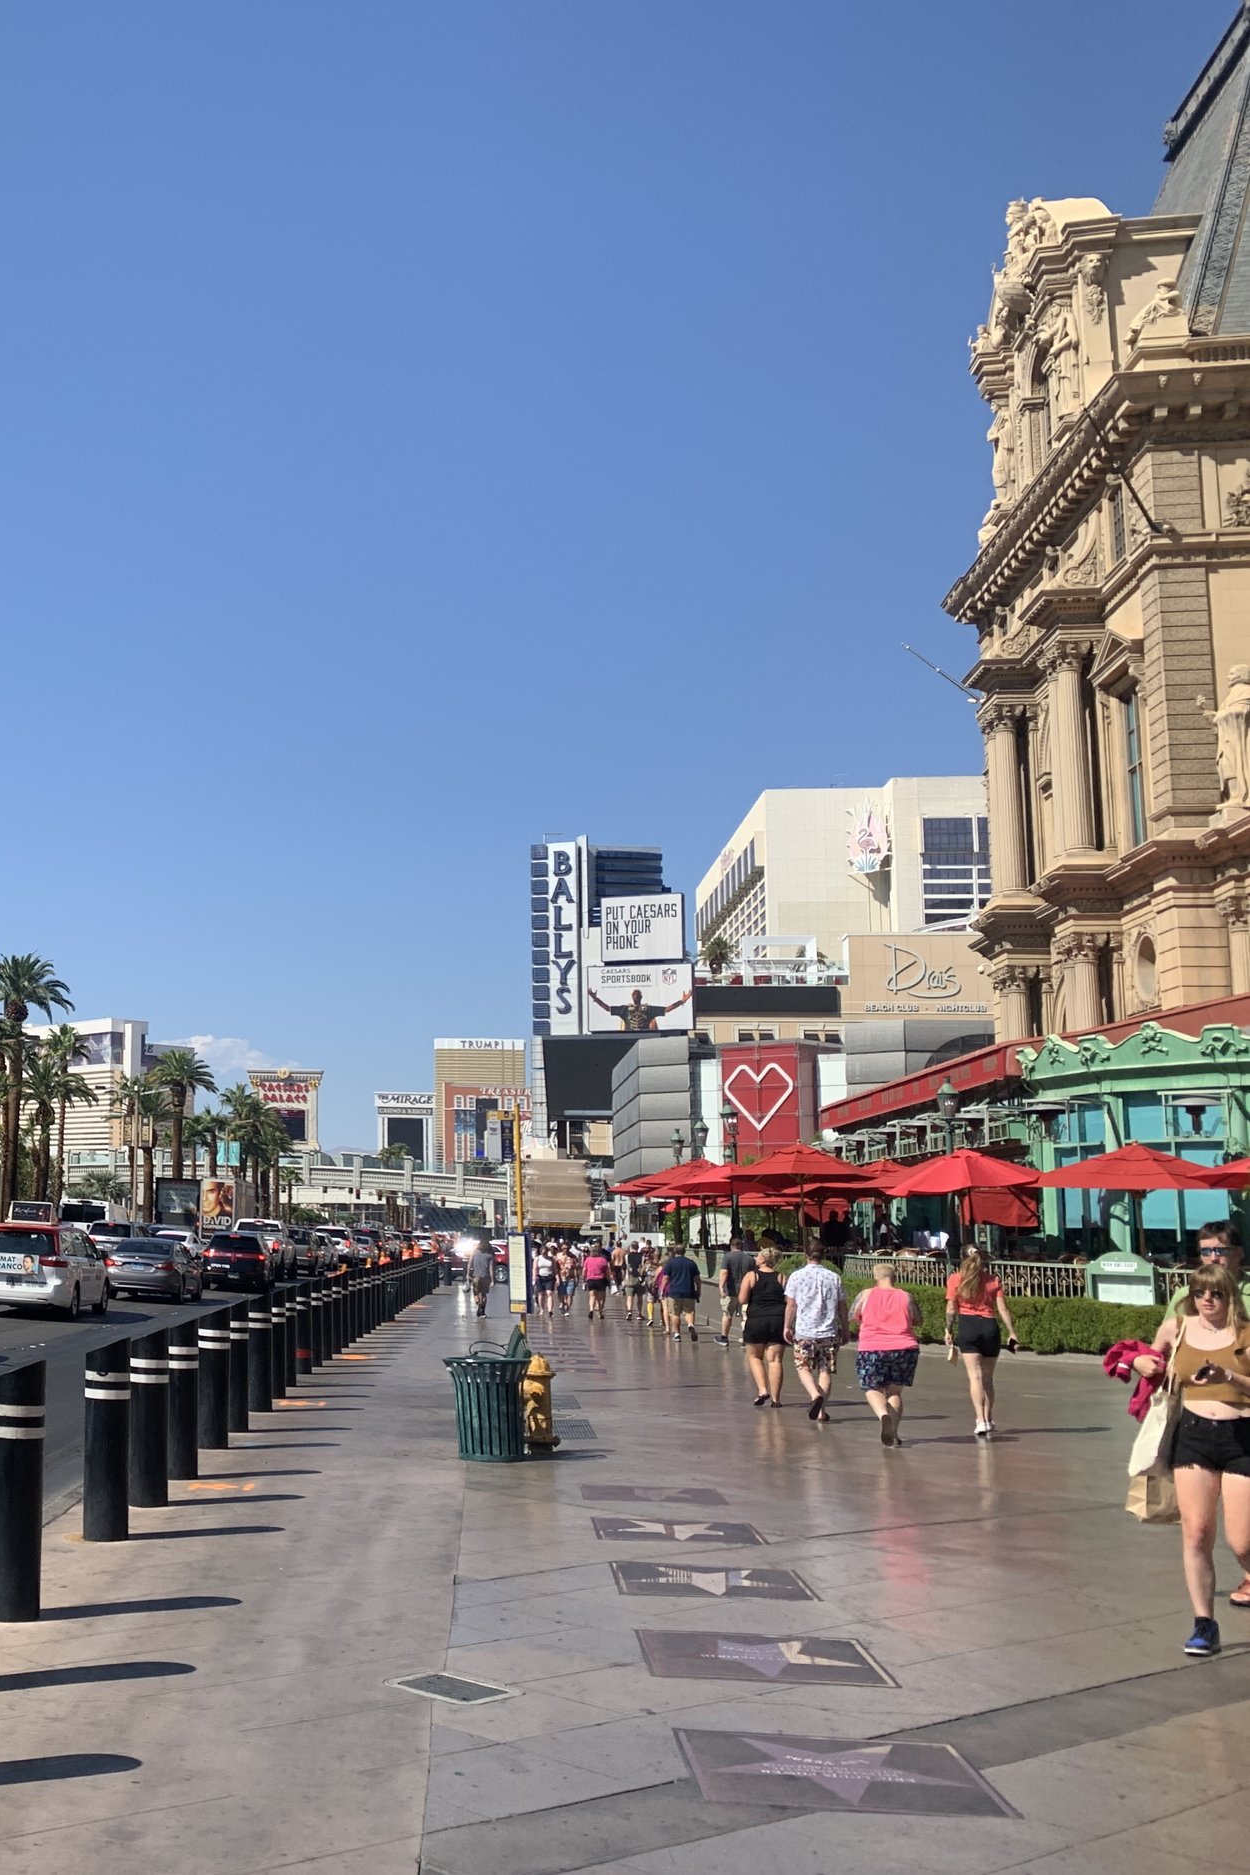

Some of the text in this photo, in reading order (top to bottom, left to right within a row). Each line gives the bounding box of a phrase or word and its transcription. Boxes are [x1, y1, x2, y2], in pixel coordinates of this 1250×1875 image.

[605, 903, 677, 920] PUT CAESARS
[605, 919, 651, 935] ON YOUR
[605, 935, 639, 950] PHONE
[601, 974, 652, 984] SPORTSBOOK
[864, 1004, 988, 1013] BEACH CLUB NIGHTCLUB
[460, 1040, 500, 1049] TRUMP
[479, 1087, 532, 1097] TREASUR
[263, 1093, 308, 1103] PALACE
[382, 1095, 434, 1105] MIRAGE
[203, 1215, 232, 1226] DAVID
